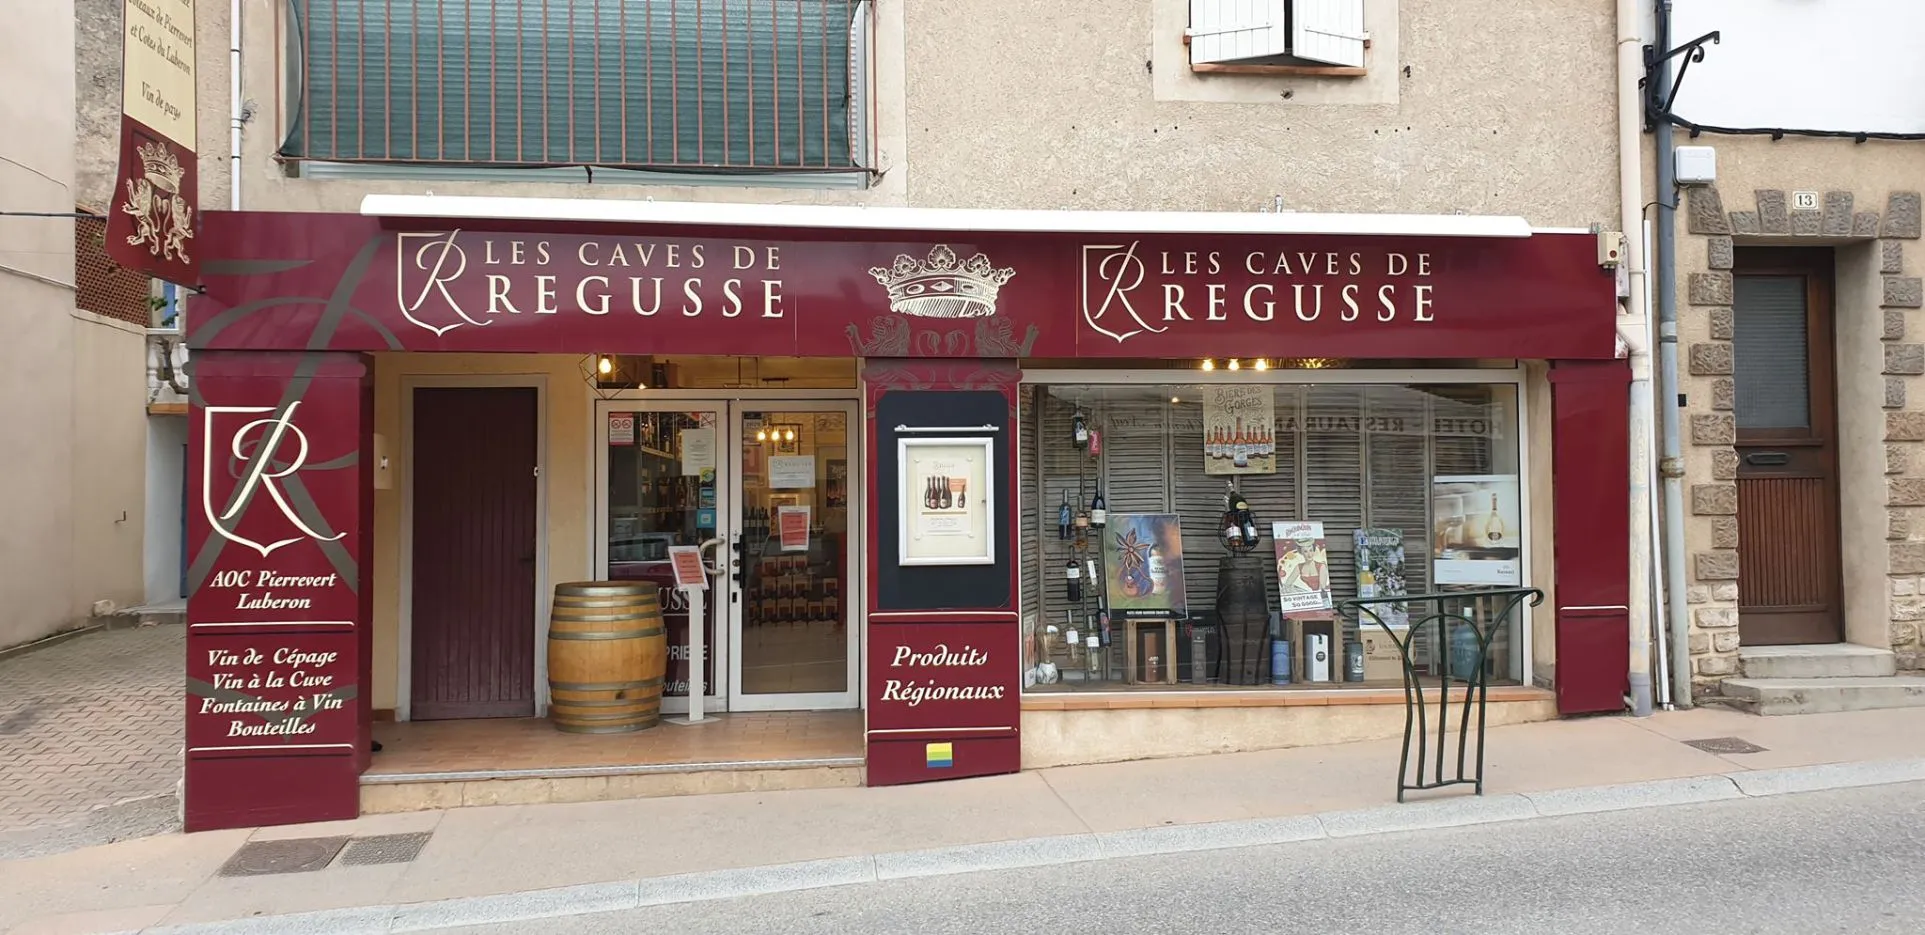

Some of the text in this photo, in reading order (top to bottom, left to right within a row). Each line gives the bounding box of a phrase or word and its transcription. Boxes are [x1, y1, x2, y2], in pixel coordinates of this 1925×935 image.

[130, 24, 137, 38] et
[166, 45, 191, 76] Luberon
[141, 80, 182, 121] Vin de pays
[1799, 194, 1812, 206] 13
[484, 240, 780, 270] LES CAVES DE
[1161, 251, 1431, 276] LES CAVES DE
[485, 274, 784, 318] REGUSSE
[1161, 283, 1434, 322] REGUSSE
[1224, 397, 1263, 416] GORGES
[210, 570, 337, 588] AOC Pierrevert
[235, 591, 311, 610] Luberon
[208, 647, 337, 669] Vin de Cépage
[890, 644, 989, 668] Produits
[213, 670, 333, 690] Vin à la Cuve
[199, 693, 343, 714] Fontaines à Vin
[880, 679, 1005, 707] Régionaux
[226, 716, 316, 737] Bouteilles
